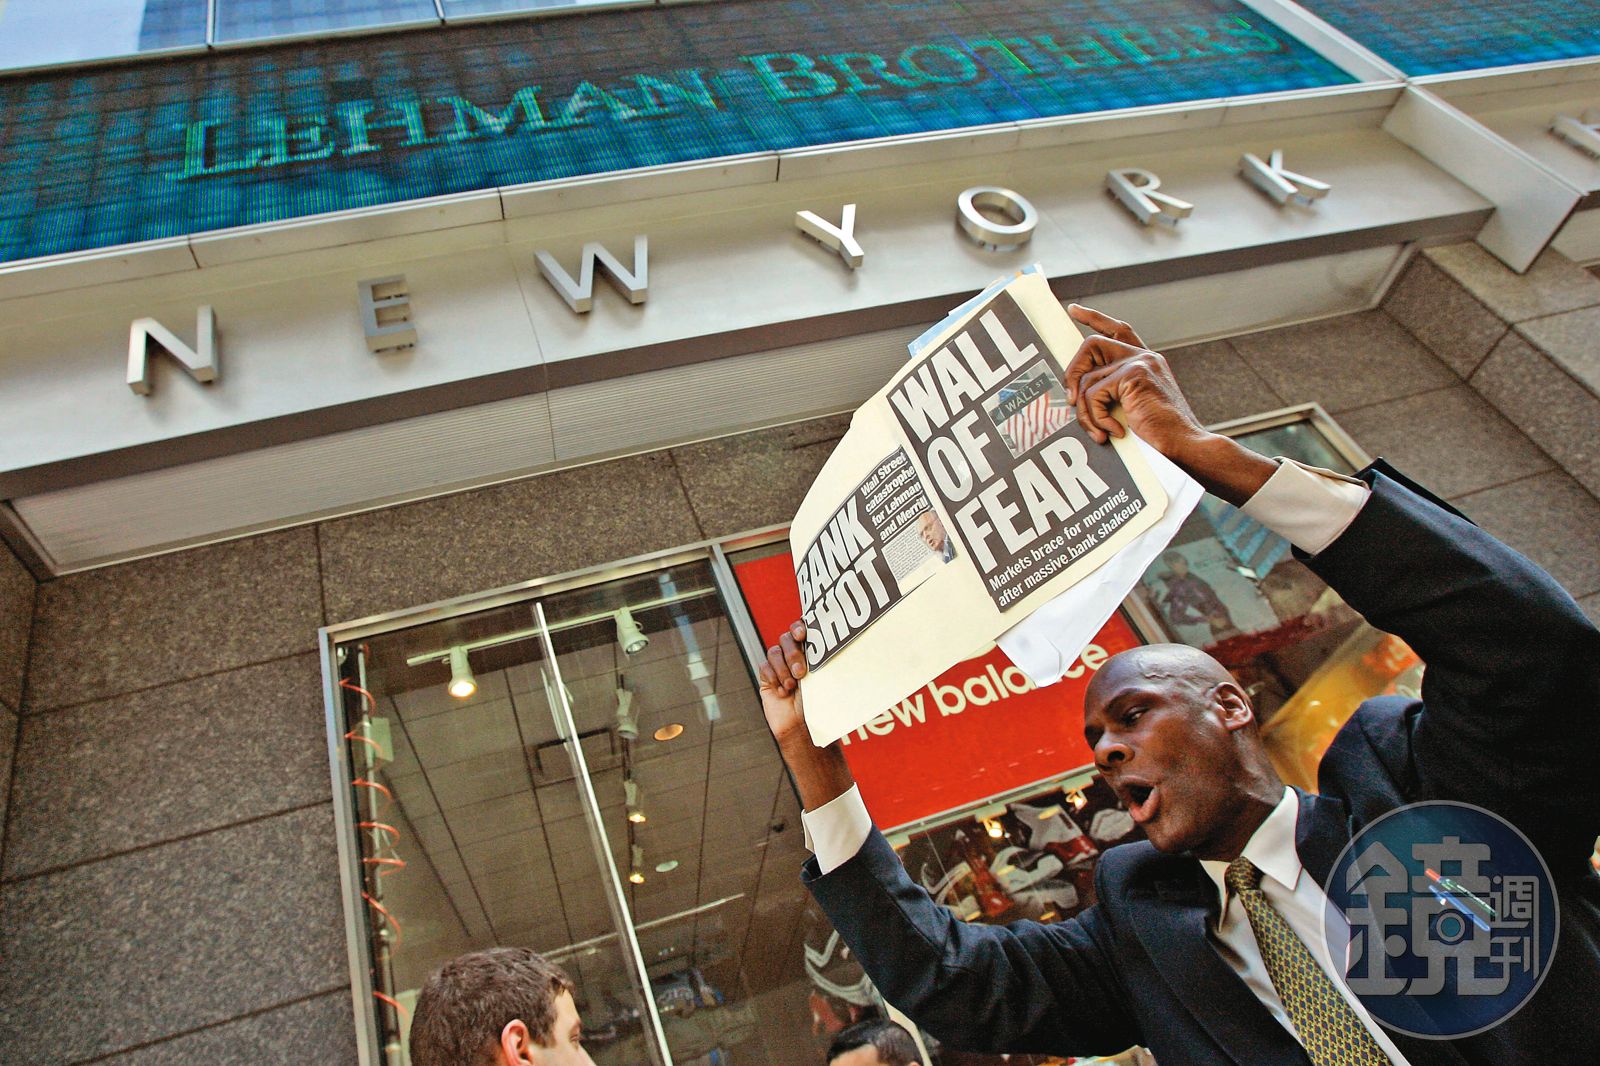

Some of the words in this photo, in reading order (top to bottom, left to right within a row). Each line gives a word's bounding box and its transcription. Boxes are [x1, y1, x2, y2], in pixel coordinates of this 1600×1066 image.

[168, 66, 720, 180] LEHMAN
[740, 14, 1283, 99] BROTHERS
[127, 235, 648, 396] NEW
[796, 150, 1331, 270] YORK
[891, 309, 1038, 443] WALL
[1005, 387, 1039, 413] WALL
[1035, 379, 1044, 388] ST
[860, 475, 880, 496] Wall
[878, 452, 906, 480] Street
[865, 465, 915, 513] catastrophe
[872, 511, 886, 527] for
[885, 481, 922, 515] Lehman
[928, 410, 994, 502] OF
[955, 436, 1110, 574] FEAR
[797, 495, 875, 614] BANK
[879, 521, 897, 541] and
[895, 495, 929, 526] Merrill
[988, 555, 1033, 591] Markets
[1030, 535, 1065, 562] brace
[1063, 523, 1082, 540] for
[1083, 488, 1128, 528] morning
[998, 583, 1024, 607] after
[1024, 554, 1069, 589] massive
[1067, 534, 1099, 561] bank
[1097, 498, 1142, 538] shakeup
[802, 546, 890, 666] SHOT
[927, 643, 1109, 716] balae
